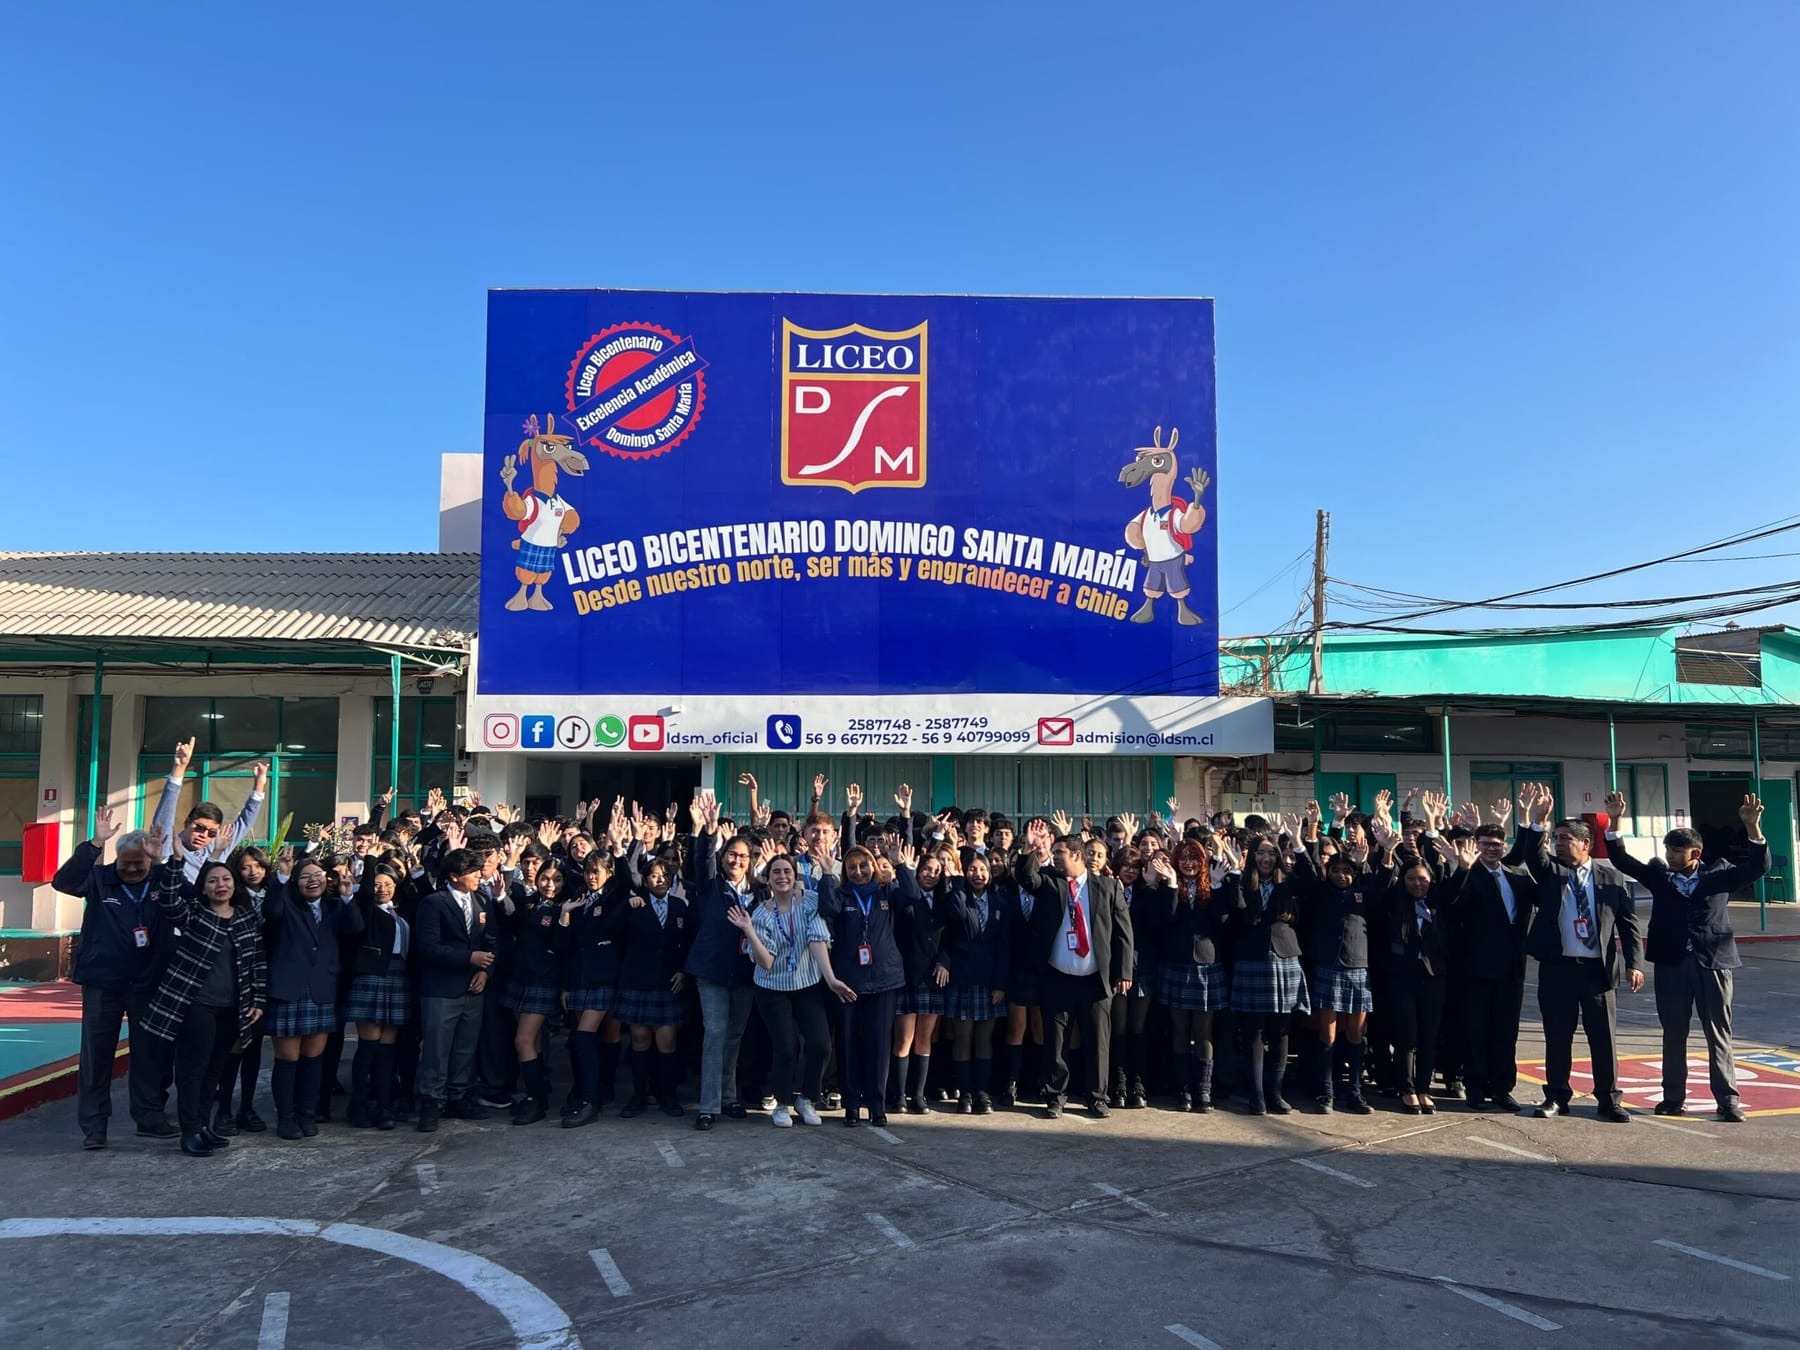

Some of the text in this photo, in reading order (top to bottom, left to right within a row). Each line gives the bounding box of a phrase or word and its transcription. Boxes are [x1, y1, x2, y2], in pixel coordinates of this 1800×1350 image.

[576, 335, 663, 397] Liceo Bicentenario
[796, 344, 914, 370] LICEO
[575, 350, 697, 432] Excelencia Académica
[795, 385, 831, 414] D
[605, 382, 693, 448] Domingo Santa María
[874, 446, 914, 475] M
[561, 519, 1138, 593] LICEO BICENTENARIO DOMINGO SANTA MARÍA
[572, 551, 1129, 621] Desde nuestro norte, ser más y engrandecer a Chile
[666, 731, 758, 746] ldsm_oficial
[805, 733, 823, 745] 56
[827, 733, 837, 745] 9
[840, 733, 908, 745] 66717522
[921, 732, 939, 744] 56
[943, 732, 952, 744] 9
[955, 731, 1031, 744] 40799099
[848, 718, 912, 732] 2587748
[925, 716, 989, 731] 2587749
[1075, 732, 1214, 748] admision@ldsm.cl
